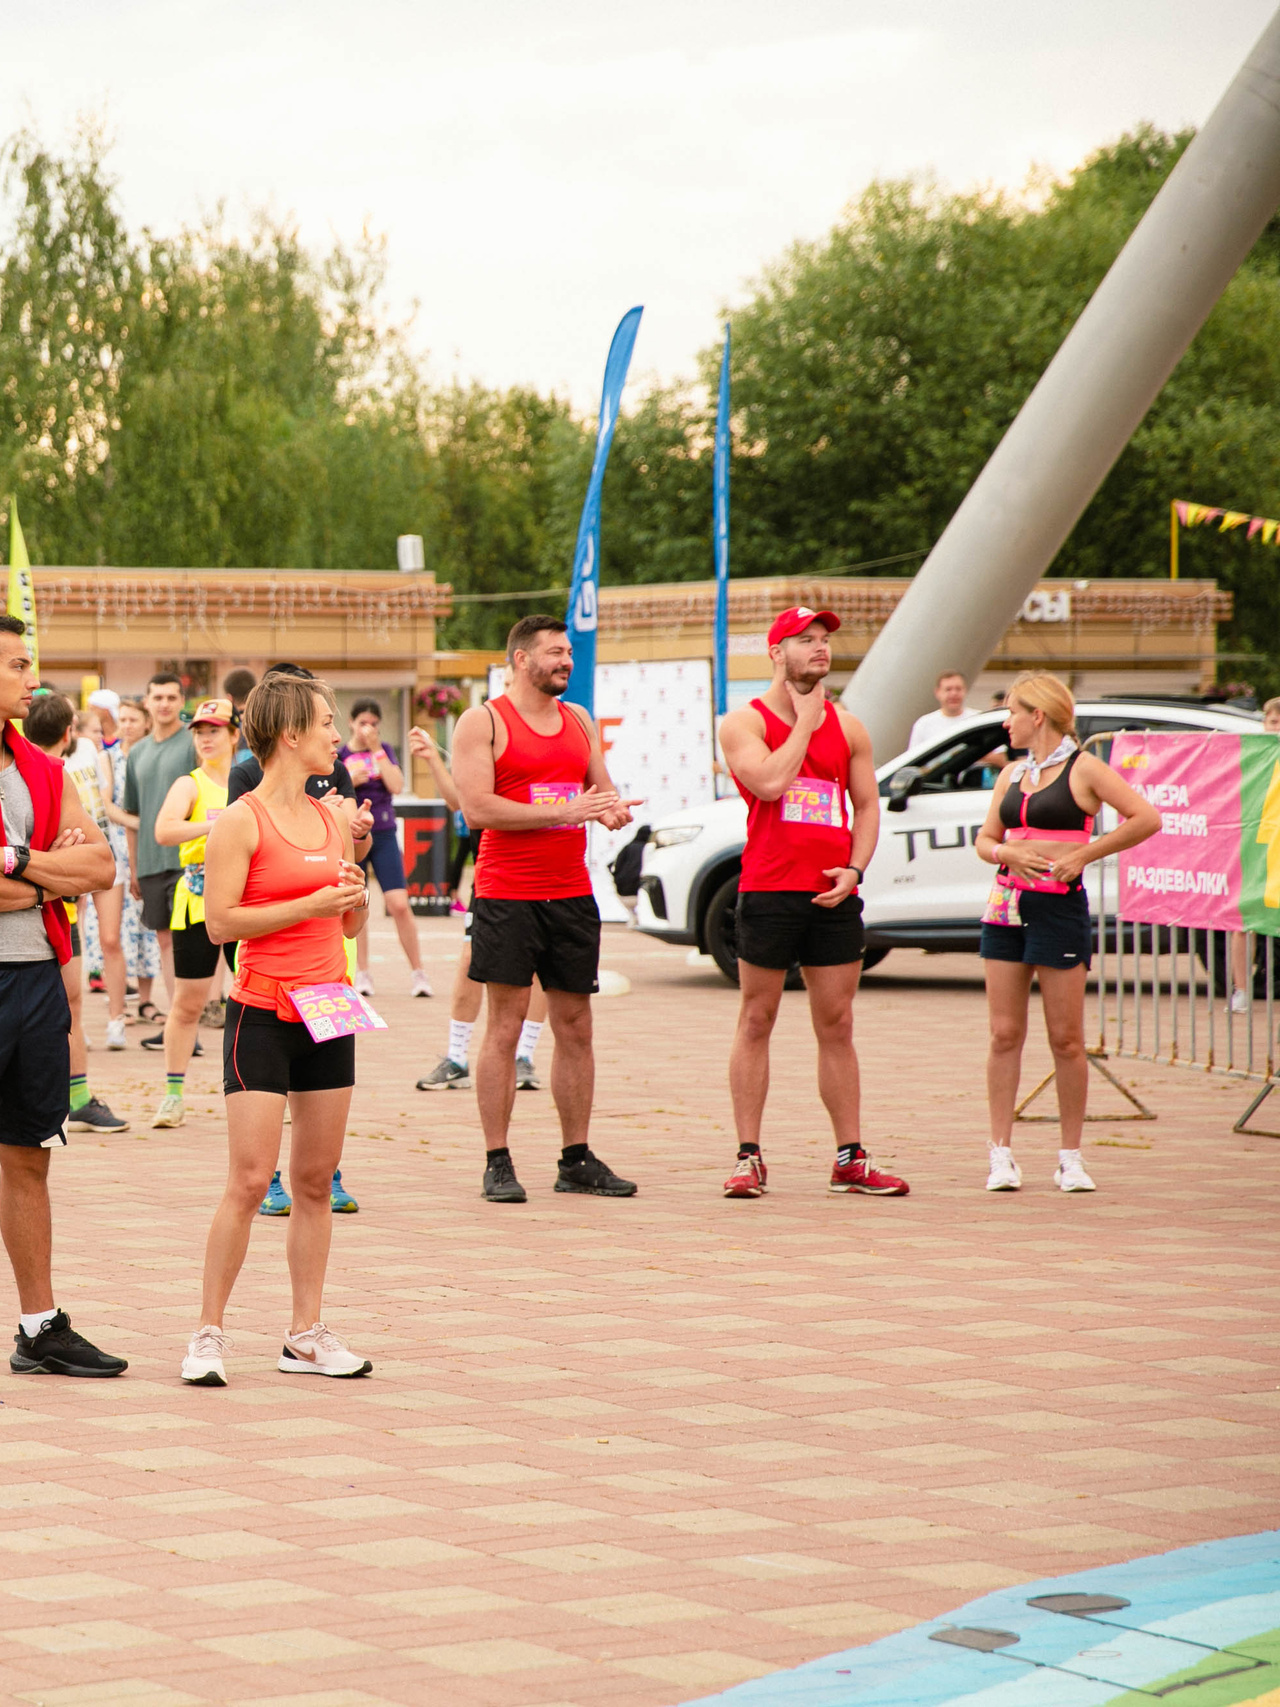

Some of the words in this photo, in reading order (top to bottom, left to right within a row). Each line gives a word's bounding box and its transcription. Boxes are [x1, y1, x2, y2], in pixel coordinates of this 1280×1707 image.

[785, 789, 820, 806] 175
[1131, 783, 1189, 808] АМЕРА
[1127, 866, 1230, 896] РАЗДЕВАЛКИ
[302, 997, 352, 1020] 263
